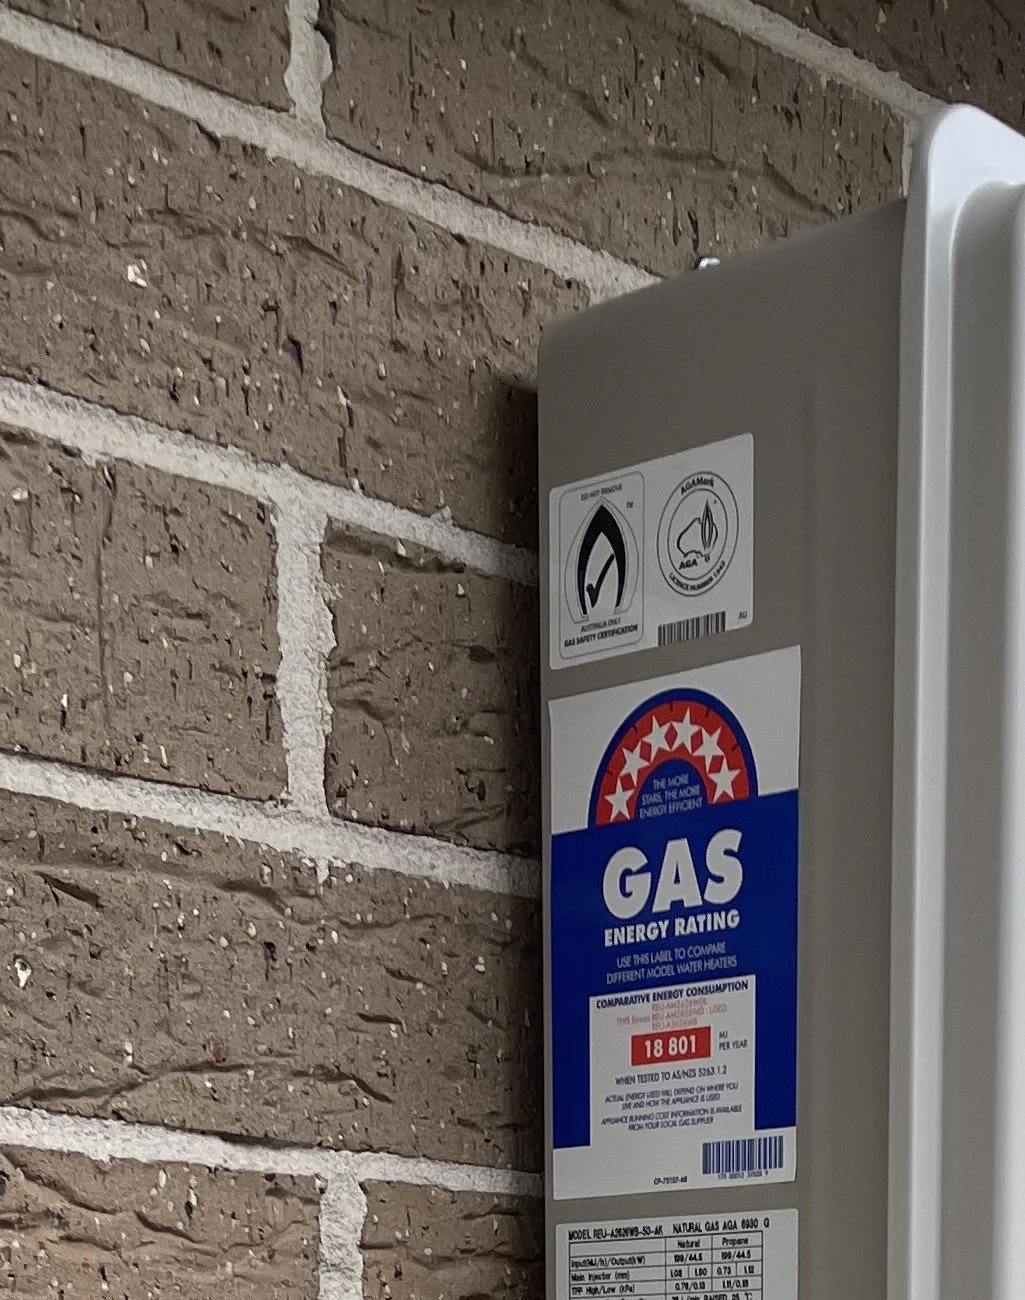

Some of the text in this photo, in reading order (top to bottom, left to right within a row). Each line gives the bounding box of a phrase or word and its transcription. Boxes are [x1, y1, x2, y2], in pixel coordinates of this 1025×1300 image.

[678, 558, 698, 570] AGA
[603, 829, 743, 920] GAS
[604, 909, 740, 947] ENERGY RATING
[616, 942, 726, 969] USE THIS LABEL TO COMPARE
[606, 955, 738, 985] DIFFERENT MODEL WATER HEATERS
[596, 980, 749, 1010] COMPARATIVE ENERGY CONSUMPTION
[644, 1034, 696, 1058] 18 801
[719, 1038, 748, 1052] PER YEAR
[569, 1228, 592, 1240] MODEL
[673, 1222, 702, 1234] NATURAL
[705, 1220, 720, 1232] GAS
